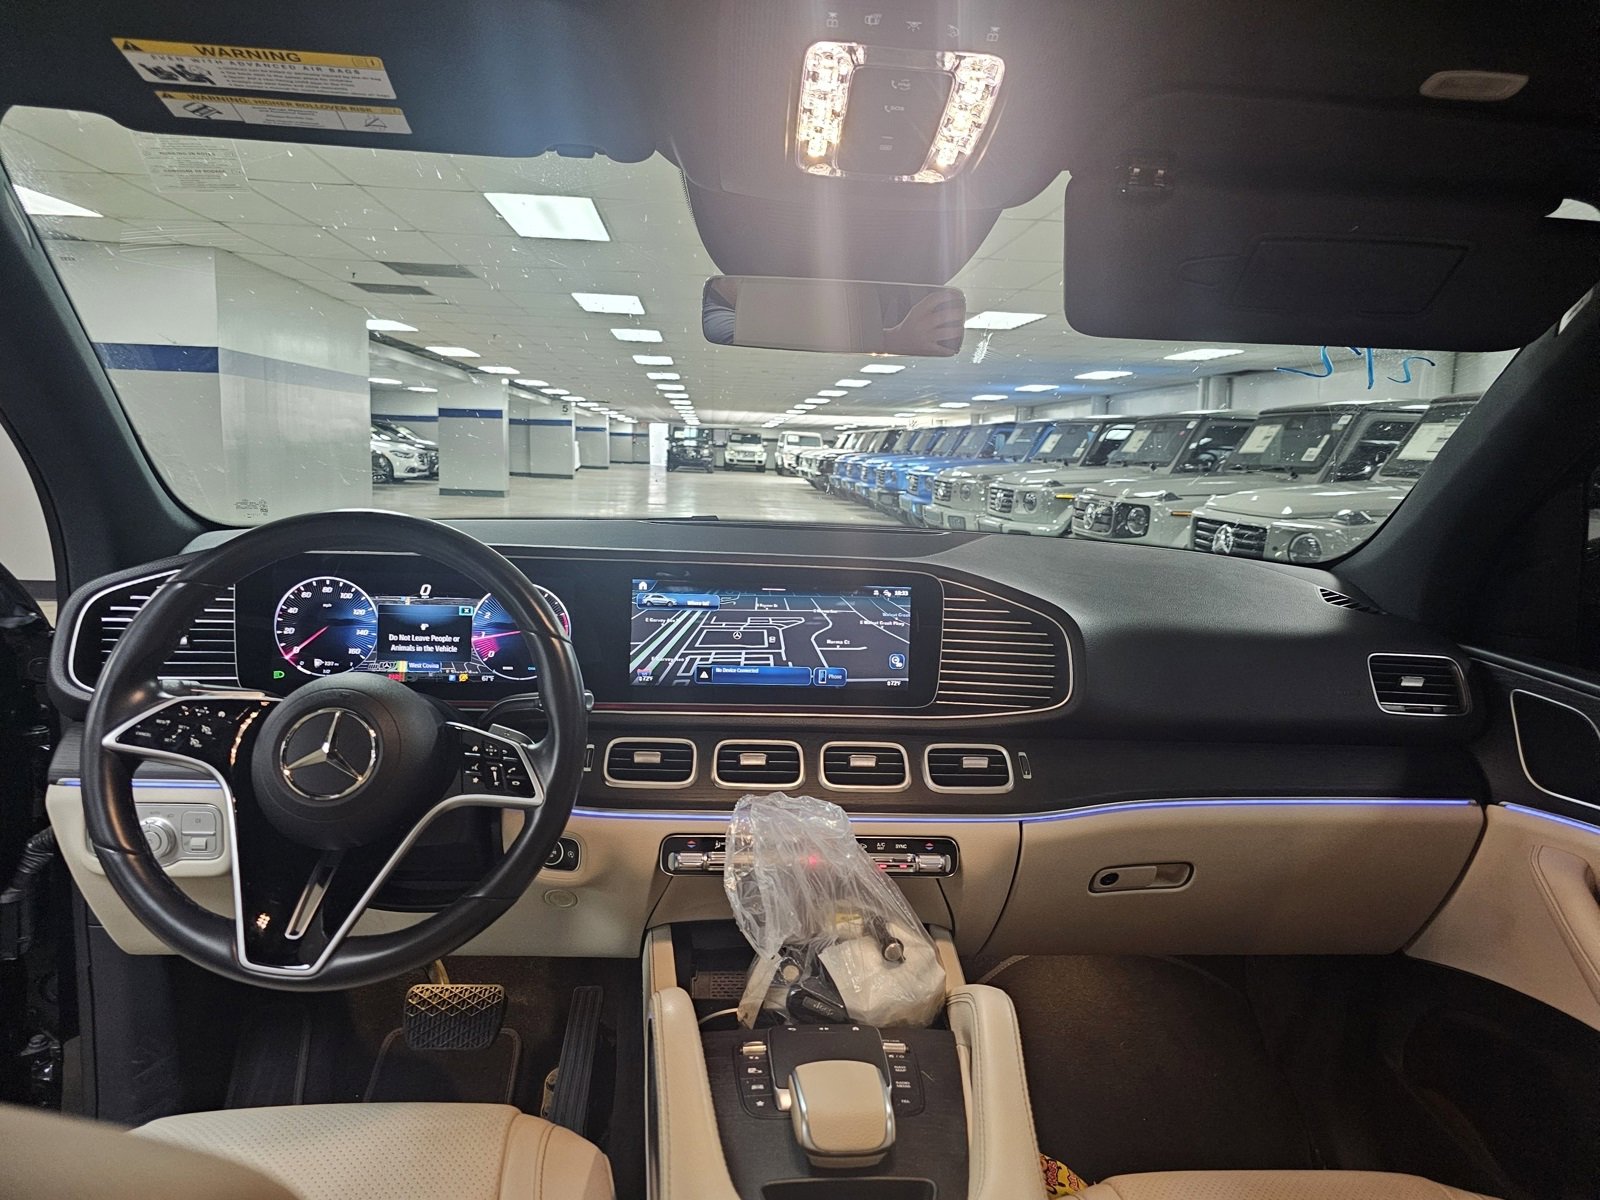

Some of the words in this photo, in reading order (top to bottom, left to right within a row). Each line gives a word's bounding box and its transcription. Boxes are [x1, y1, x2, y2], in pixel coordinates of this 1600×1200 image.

[192, 45, 302, 63] WARNING
[229, 61, 297, 70] ADVANCED
[562, 404, 569, 413] 5
[420, 584, 432, 596] 0
[484, 611, 491, 619] 2
[283, 627, 295, 635] 20
[431, 635, 452, 643] People
[390, 644, 416, 652] Animals
[435, 645, 458, 653] Vehicle
